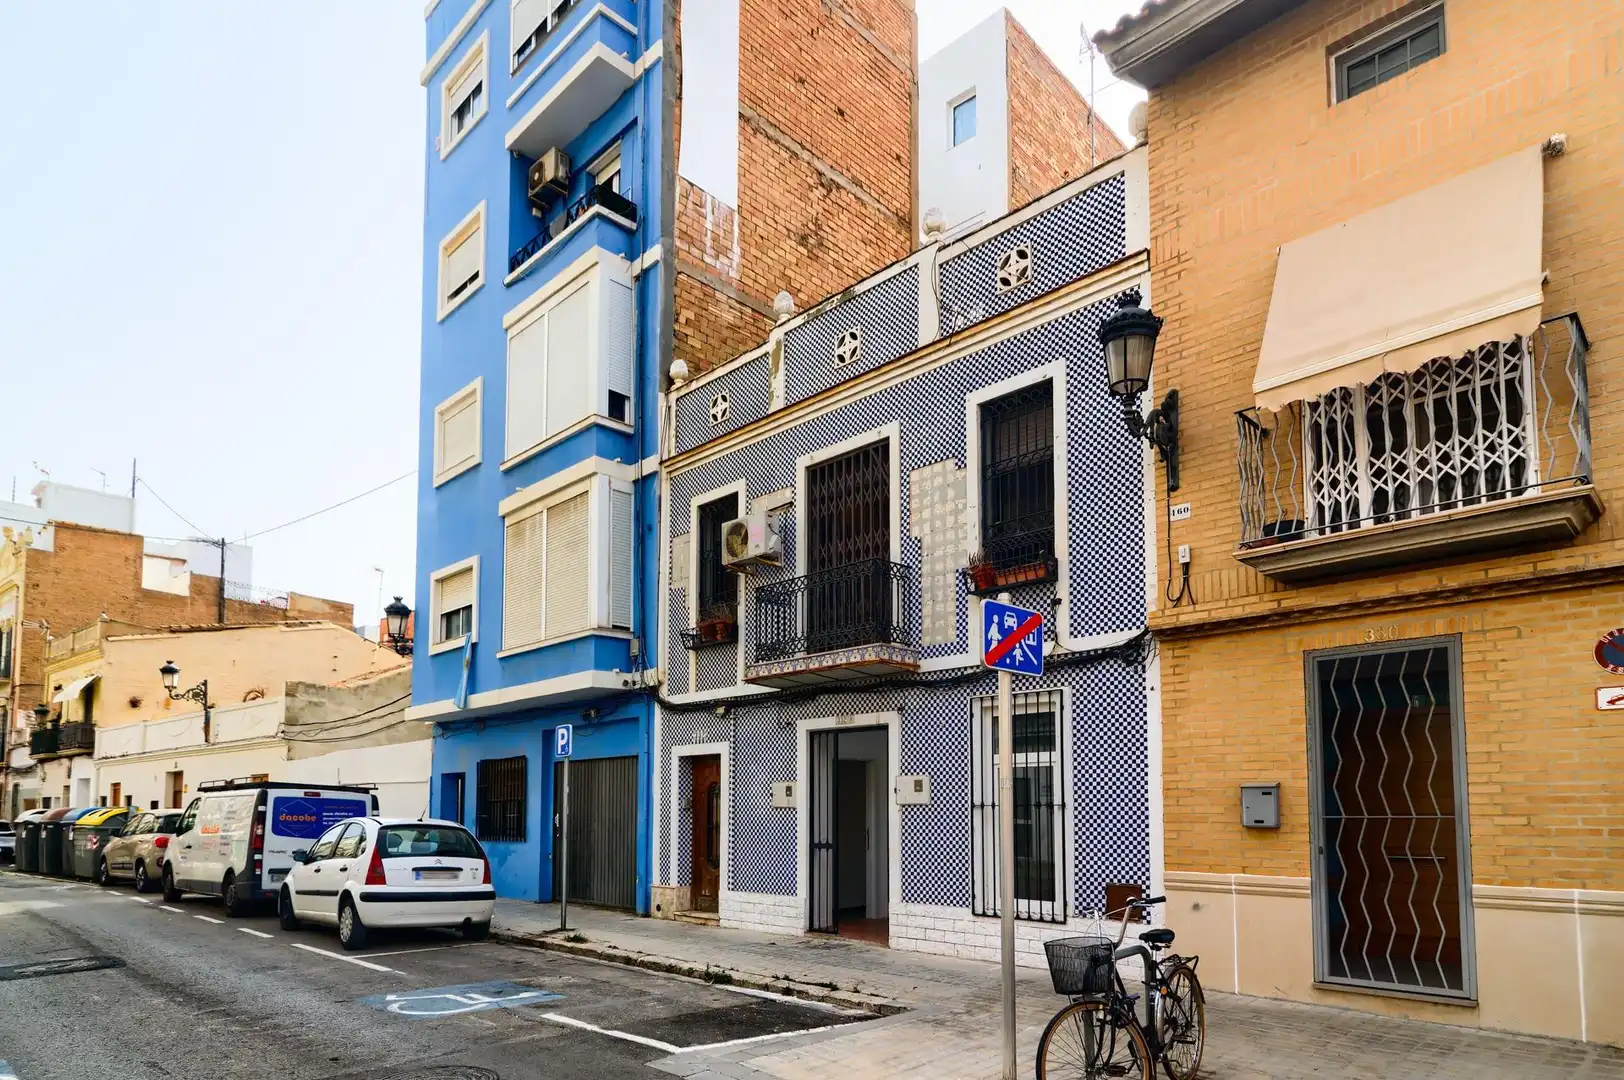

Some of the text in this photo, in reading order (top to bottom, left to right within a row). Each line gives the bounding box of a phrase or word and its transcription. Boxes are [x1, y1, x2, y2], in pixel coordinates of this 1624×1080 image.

[1172, 506, 1189, 516] 160
[557, 728, 568, 754] P
[279, 813, 317, 821] dacobe
